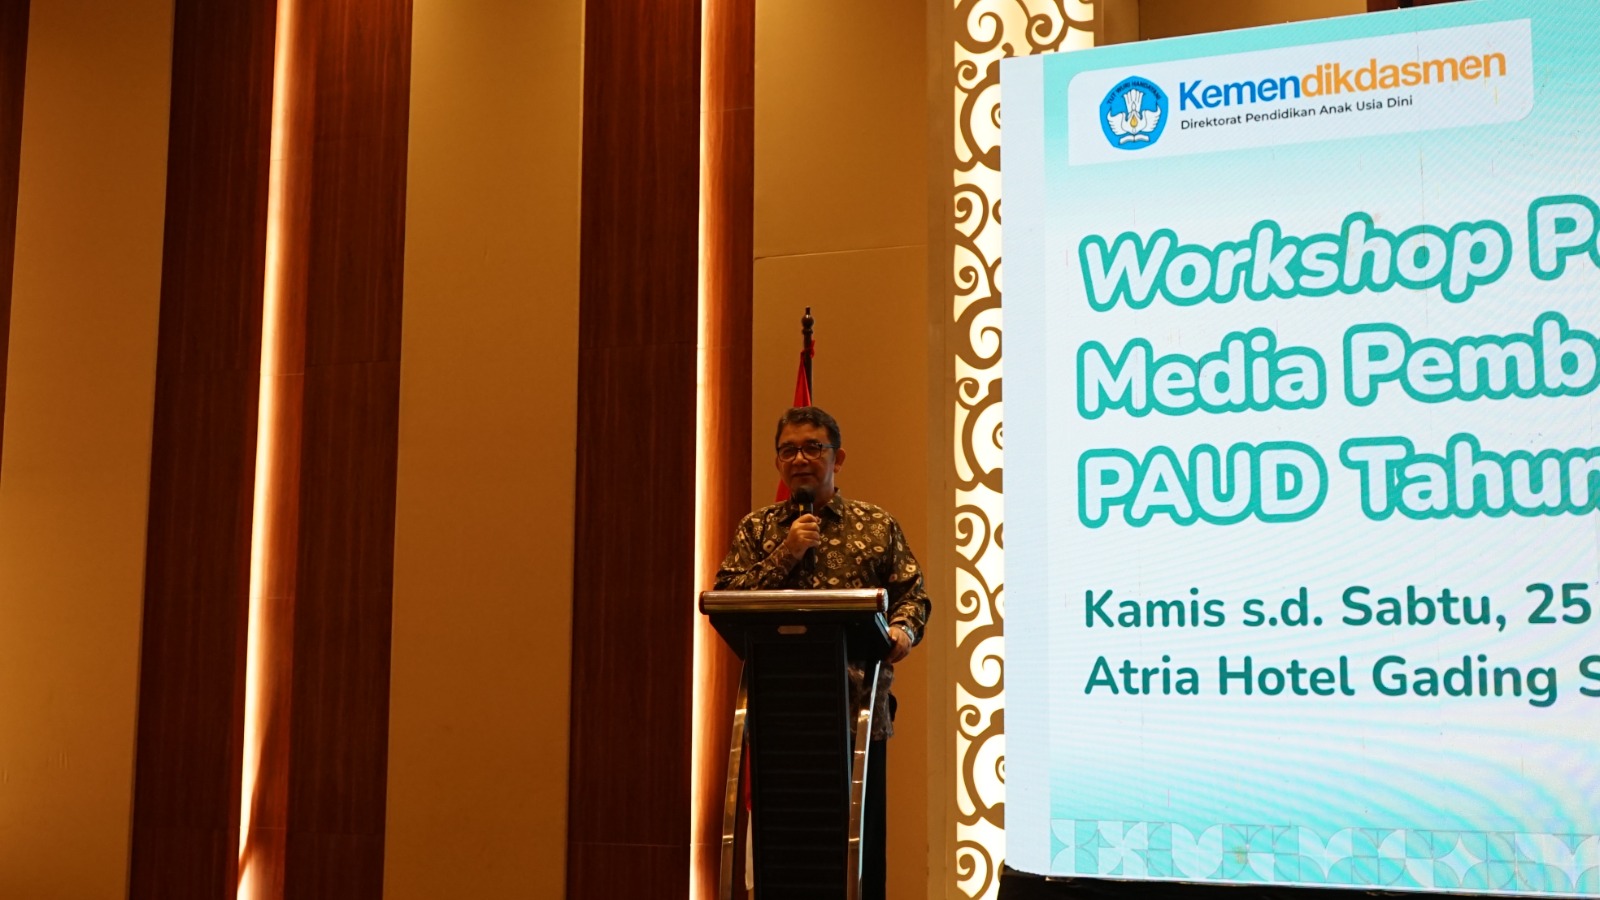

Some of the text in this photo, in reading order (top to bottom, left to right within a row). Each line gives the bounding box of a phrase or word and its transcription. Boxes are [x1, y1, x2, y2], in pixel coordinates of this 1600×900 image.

[1179, 51, 1507, 111] Kemendikdasmen
[1181, 94, 1413, 130] Direktorat Pendidikan Anak Usia Dini
[1079, 194, 1600, 312] Workshop P
[1077, 311, 1600, 419] Media Pemb
[1078, 441, 1328, 528] PAUD
[1085, 583, 1592, 632] Kamis s.d. Sabtu, 25
[1084, 654, 1199, 696] Atria
[1218, 655, 1356, 696] Hotel
[1372, 654, 1558, 708] Gading
